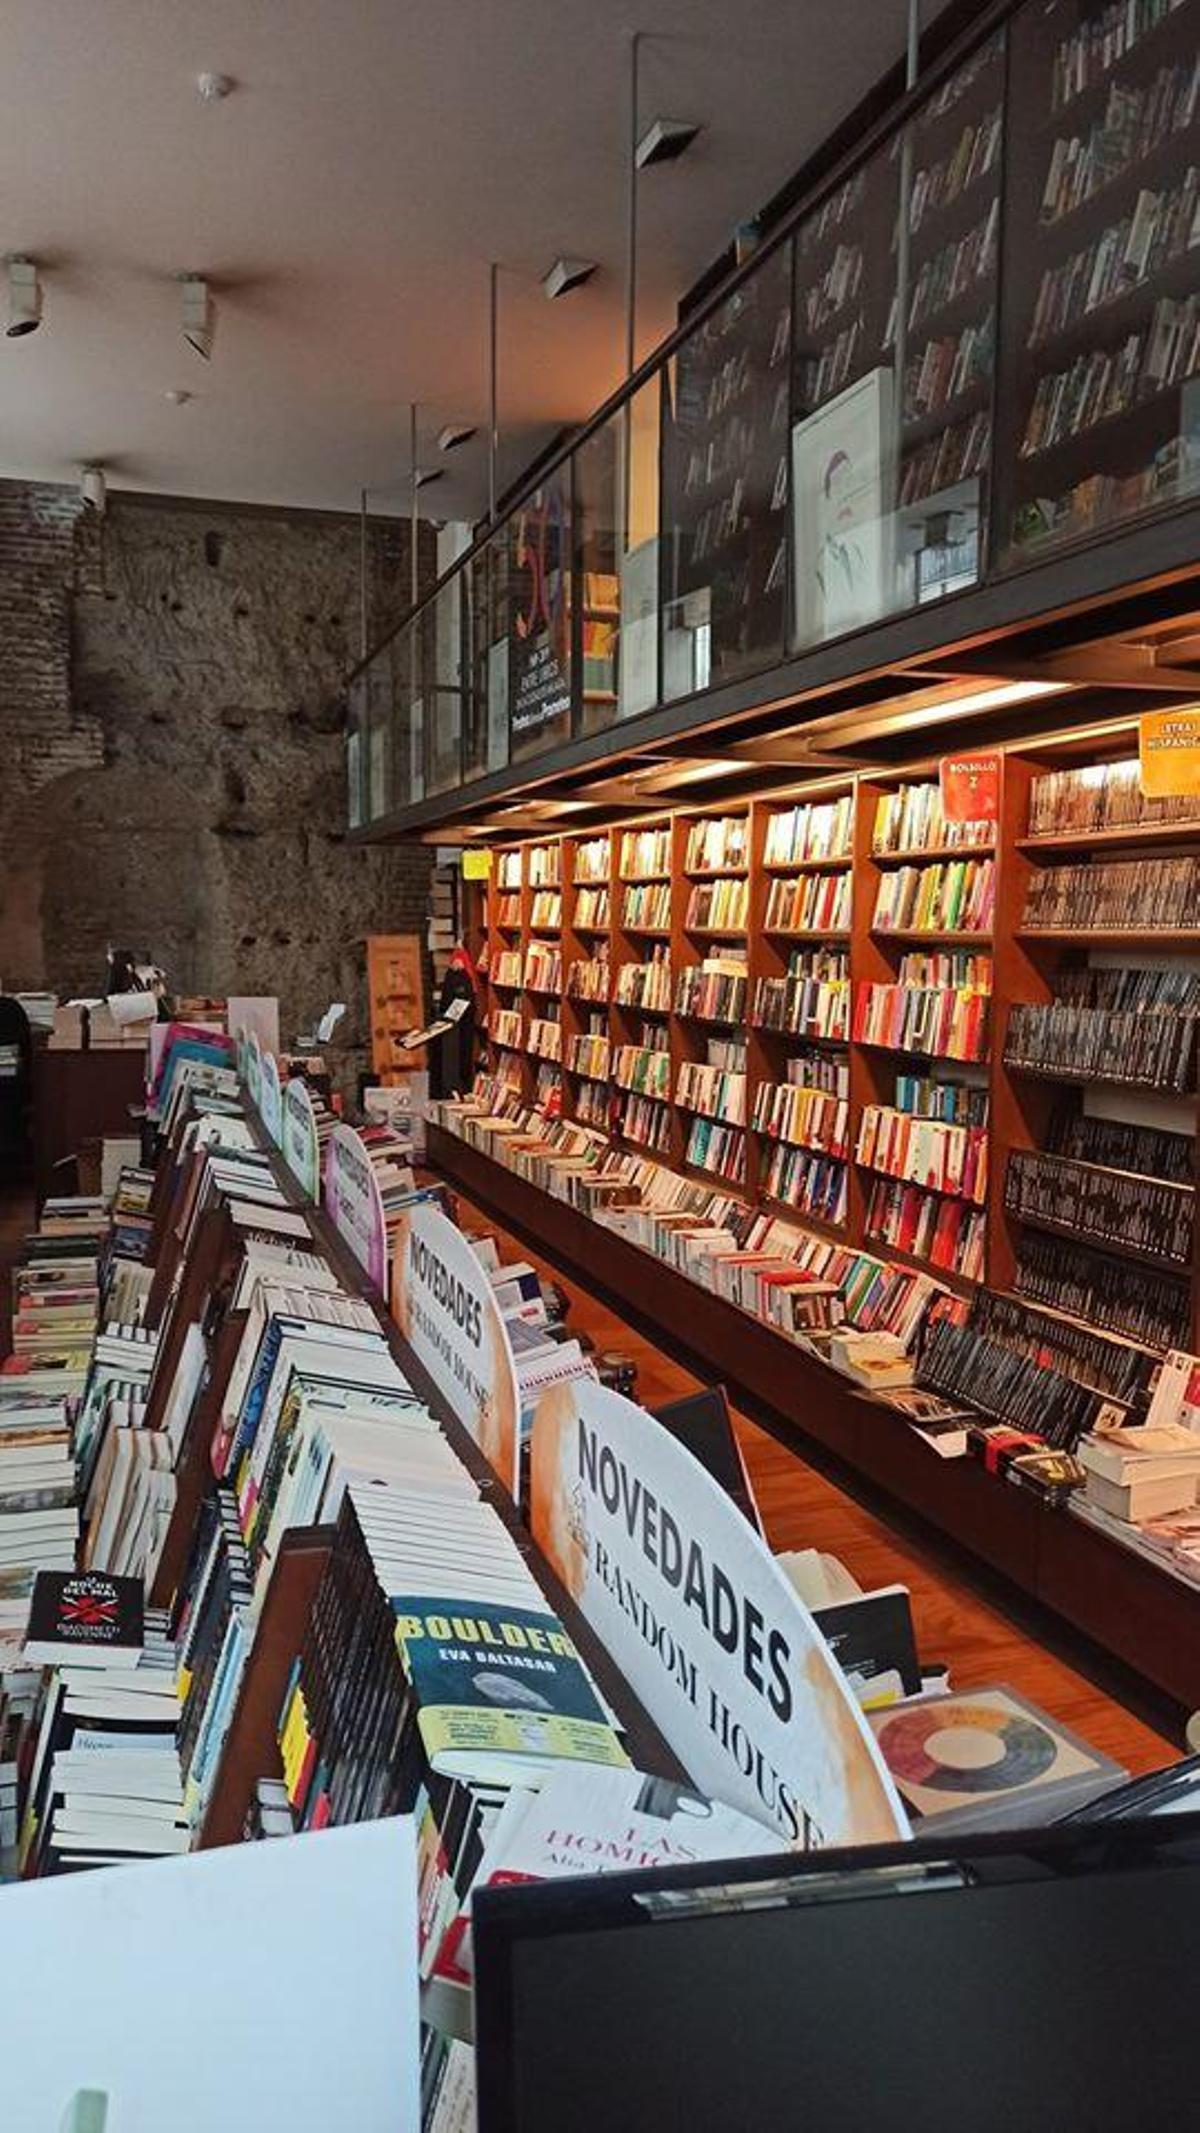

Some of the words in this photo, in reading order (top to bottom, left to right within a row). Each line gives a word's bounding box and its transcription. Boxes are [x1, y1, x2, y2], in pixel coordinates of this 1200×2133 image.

[410, 1231, 482, 1348] NOVEDADES
[63, 1586, 88, 1596] DEL
[90, 1589, 119, 1598] MAL
[69, 1580, 112, 1590] NOCHE
[578, 1417, 793, 1724] NOVEDADES
[396, 1614, 578, 1659] BOULDER
[595, 1539, 699, 1709] RANDOM
[438, 1648, 472, 1662] EVA
[475, 1649, 558, 1674] BALTASAR
